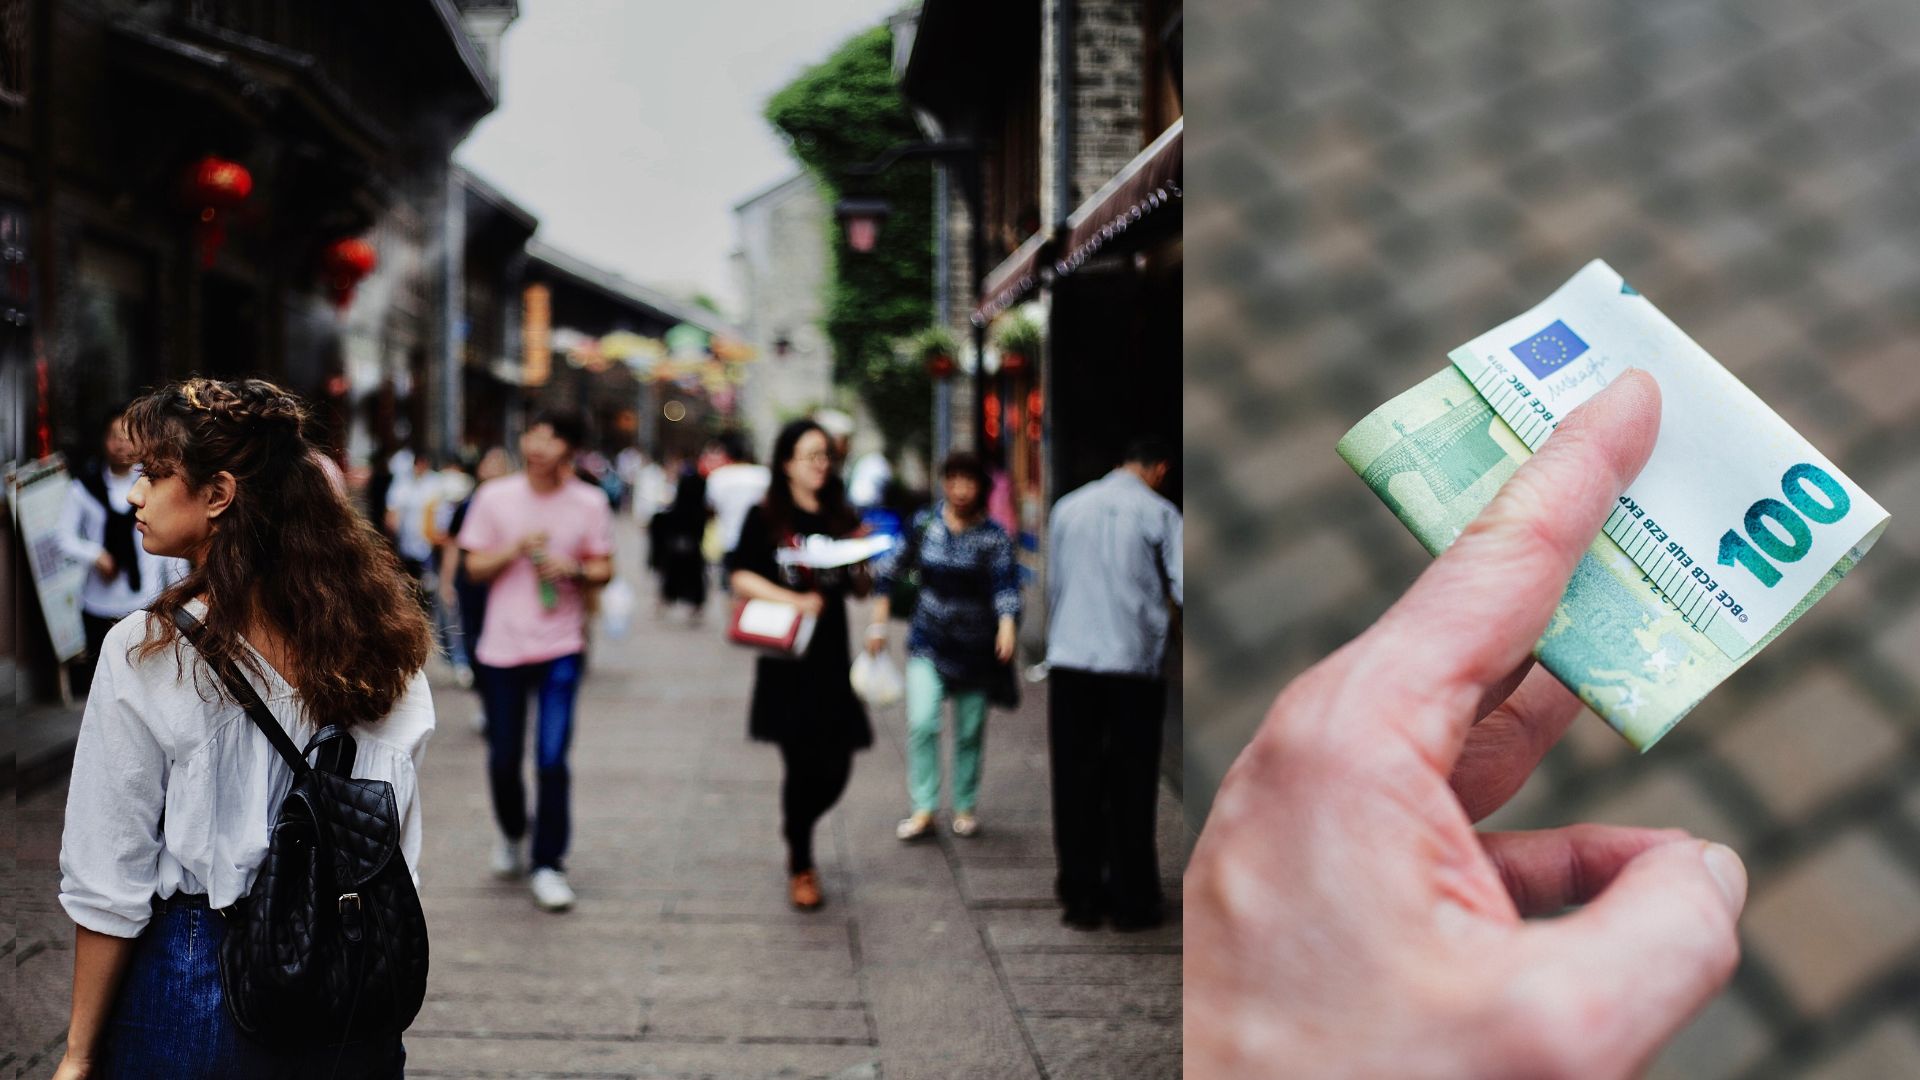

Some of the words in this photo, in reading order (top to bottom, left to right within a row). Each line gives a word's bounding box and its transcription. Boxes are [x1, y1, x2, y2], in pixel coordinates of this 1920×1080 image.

[1506, 374, 1531, 398] EBC
[1618, 496, 1645, 519] EKP
[1642, 518, 1669, 543] EZB
[1717, 463, 1851, 588] 100
[1665, 542, 1694, 568] ЕЦБ
[1691, 566, 1719, 592] ECB
